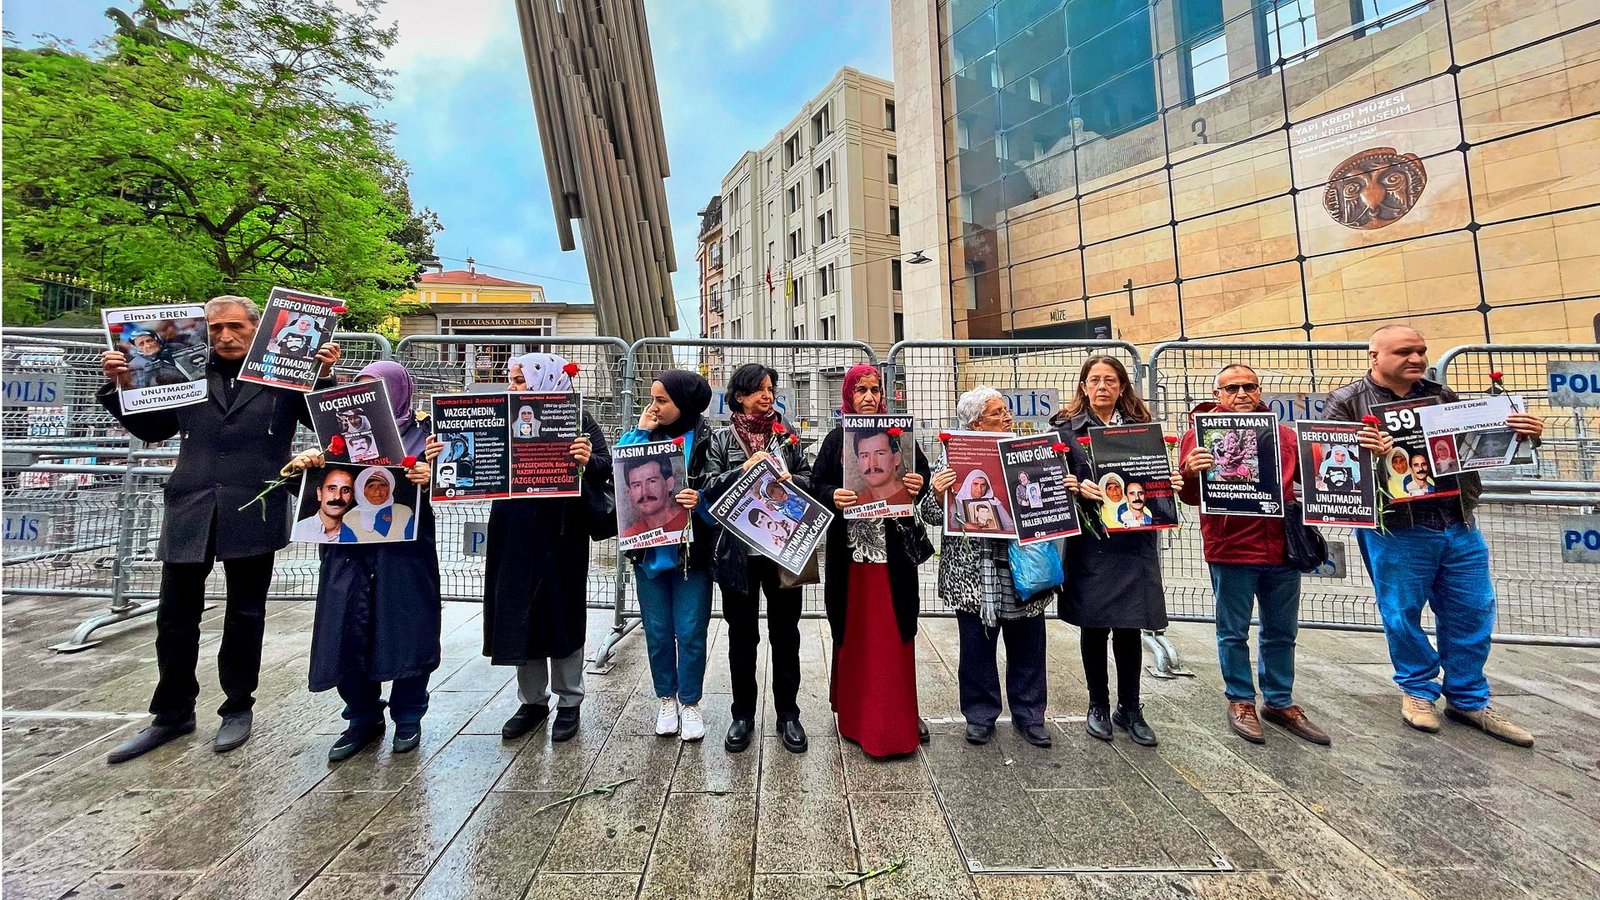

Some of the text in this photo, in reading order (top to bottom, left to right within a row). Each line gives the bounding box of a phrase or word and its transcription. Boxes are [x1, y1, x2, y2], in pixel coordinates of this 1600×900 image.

[1296, 92, 1405, 136] YAPI KREDİ MÜZESİ
[1356, 104, 1411, 127] MUSEUM
[1191, 117, 1208, 145] 3
[272, 298, 300, 310] BERFO
[123, 310, 188, 320] Elmas EREN
[1050, 308, 1066, 322] MÜZE
[456, 319, 510, 327] GALATASARAY
[262, 354, 312, 370] UNUTMADIN
[248, 362, 316, 380] UNUTMAYACAĞZ!
[132, 390, 202, 406] UNUTMAYACAĞIZ!
[319, 397, 352, 412] KOÇERİ
[352, 392, 376, 404] KURT
[1003, 391, 1051, 416] LİS
[444, 406, 496, 418] VAZGEÇMEDİN,
[1268, 396, 1325, 422] OLİS
[436, 416, 506, 430] VAZGEÇMEYECEĞİZ!
[845, 418, 913, 428] KASIM ALPSOY
[1202, 418, 1268, 427] SAFFET YAMAN
[1427, 427, 1460, 436] UNUTMADIN
[1464, 421, 1507, 430] UNUTMAYACA
[1302, 432, 1360, 443] BERFO KIRBAY
[614, 446, 644, 459] KASIM
[1006, 450, 1033, 465] ZEYNEP
[717, 462, 768, 517] CEVRİYE ALTUNBAŞ
[1208, 483, 1256, 492] VAZGEÇMEDİN,
[1208, 490, 1272, 500] VAZGEÇMEYECEĞİZ!
[1316, 494, 1362, 505] UNUTMADIN
[844, 507, 861, 515] MAYIS
[1306, 503, 1372, 516] UNUTMAYACAĞIZ!
[2, 515, 40, 541] LİS
[620, 538, 638, 547] MAYIS
[780, 522, 809, 562] UNUTMADIN
